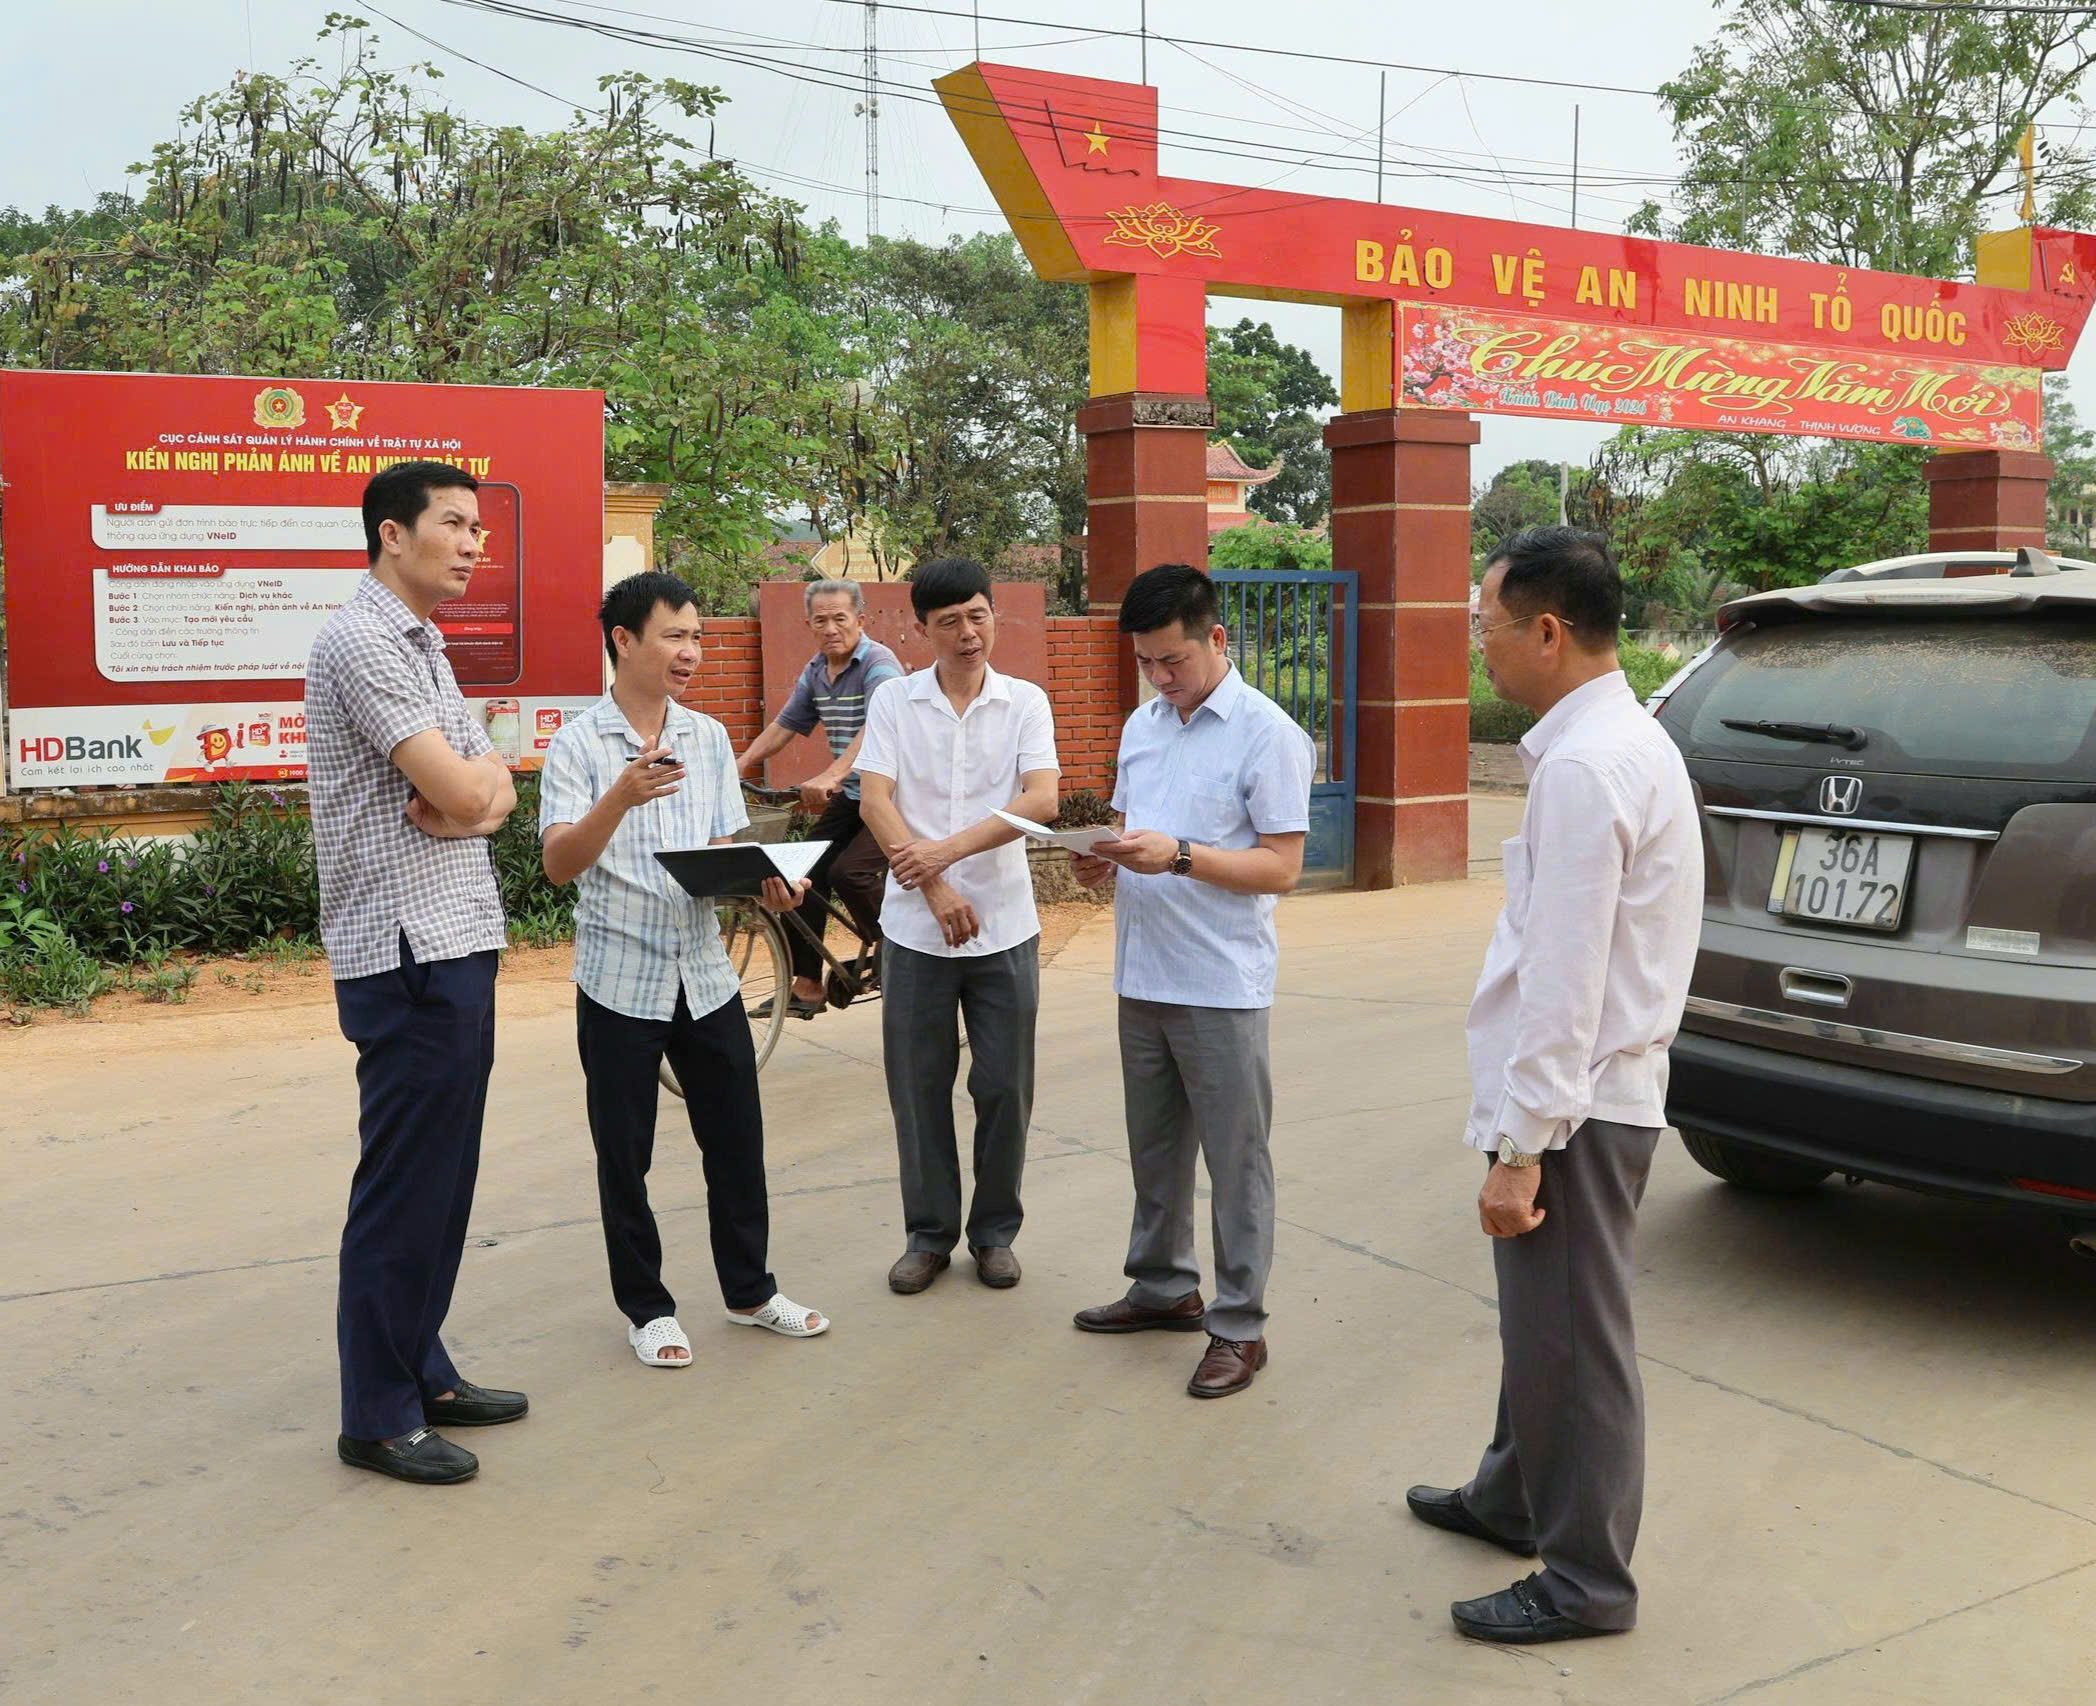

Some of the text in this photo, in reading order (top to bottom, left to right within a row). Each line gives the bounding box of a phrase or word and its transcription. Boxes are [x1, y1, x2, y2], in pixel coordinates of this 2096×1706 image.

[1355, 228, 1967, 346] BẢO VỆ AN NINH TỔ QUỐC
[1451, 327, 2011, 421] Chúc Mừng Năm Mới
[1614, 398, 1647, 415] 2026
[1717, 414, 1737, 425] AN
[1741, 416, 1786, 429] KHANG
[159, 432, 461, 451] CỤC CẢNH SÁT QUẢN LÝ HÀNH CHÍNH VỀ TRẬT TỰ XÃ HỘI
[126, 445, 169, 470] KIẾN
[175, 452, 218, 475] NGHỊ
[224, 447, 273, 472] PHẢN
[278, 450, 315, 472] ÁNH
[320, 449, 341, 473] VỀ
[347, 455, 371, 473] AN
[468, 456, 491, 479] TỰ
[115, 500, 153, 511] ƯU ĐIỂM
[206, 532, 237, 540] VNeID
[113, 562, 219, 573] HƯỚNG DẪN KHAI BÁO
[240, 592, 258, 600] Dịch
[184, 616, 199, 624] Tạo
[192, 639, 209, 648] Tiếp
[20, 735, 142, 763] HDBank
[21, 767, 43, 777] Cam
[48, 766, 65, 775] kết
[108, 765, 125, 773] cao
[130, 763, 154, 772] nhất
[1820, 832, 1880, 876] 36A
[1795, 874, 1898, 923] 101.72
